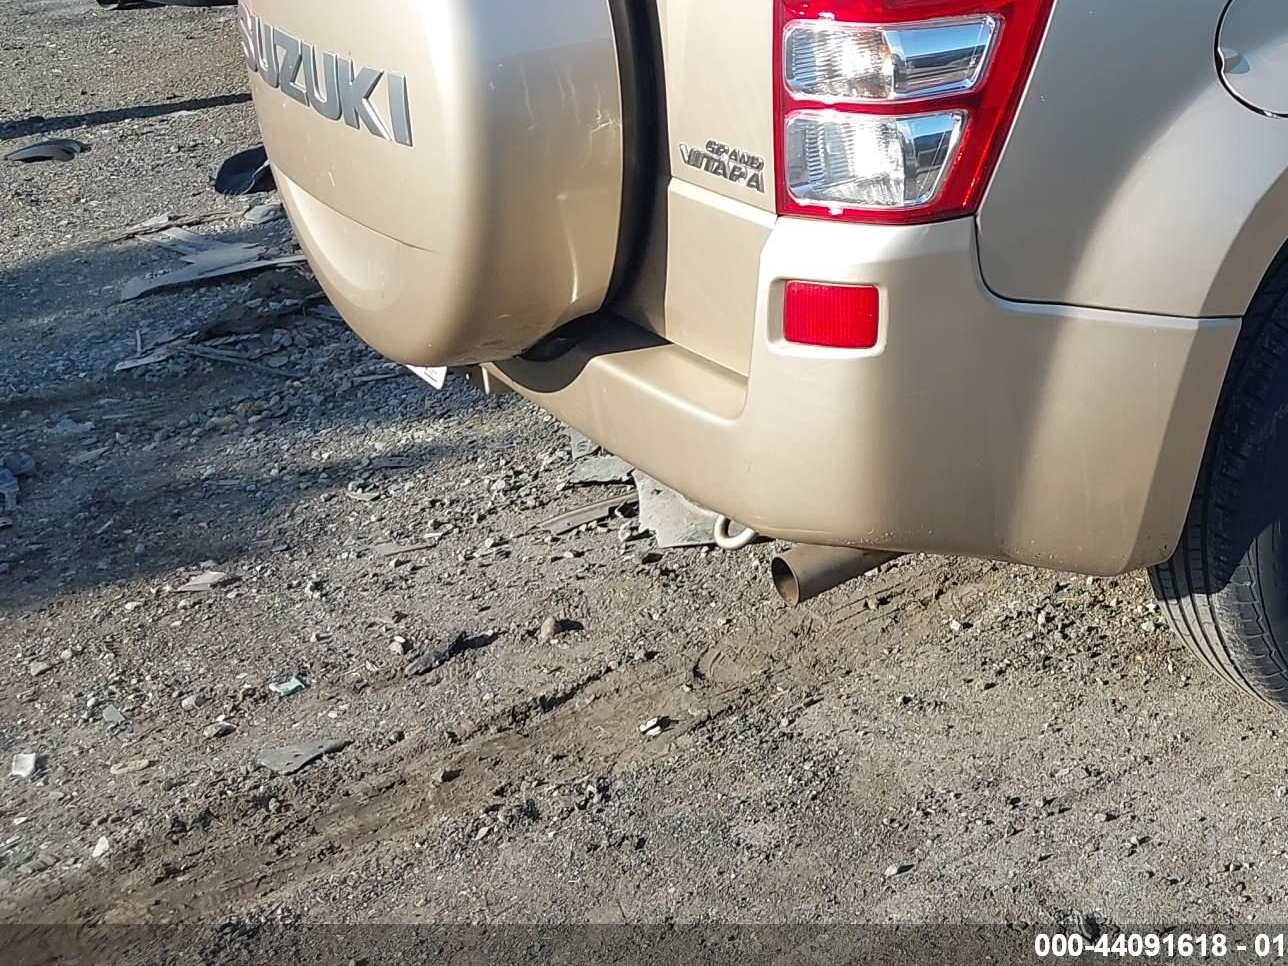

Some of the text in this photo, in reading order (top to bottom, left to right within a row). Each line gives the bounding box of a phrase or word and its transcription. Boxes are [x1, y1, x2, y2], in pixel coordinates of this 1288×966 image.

[240, 1, 414, 148] SUZUKI
[679, 143, 765, 194] VITARA
[705, 139, 765, 171] GRAND
